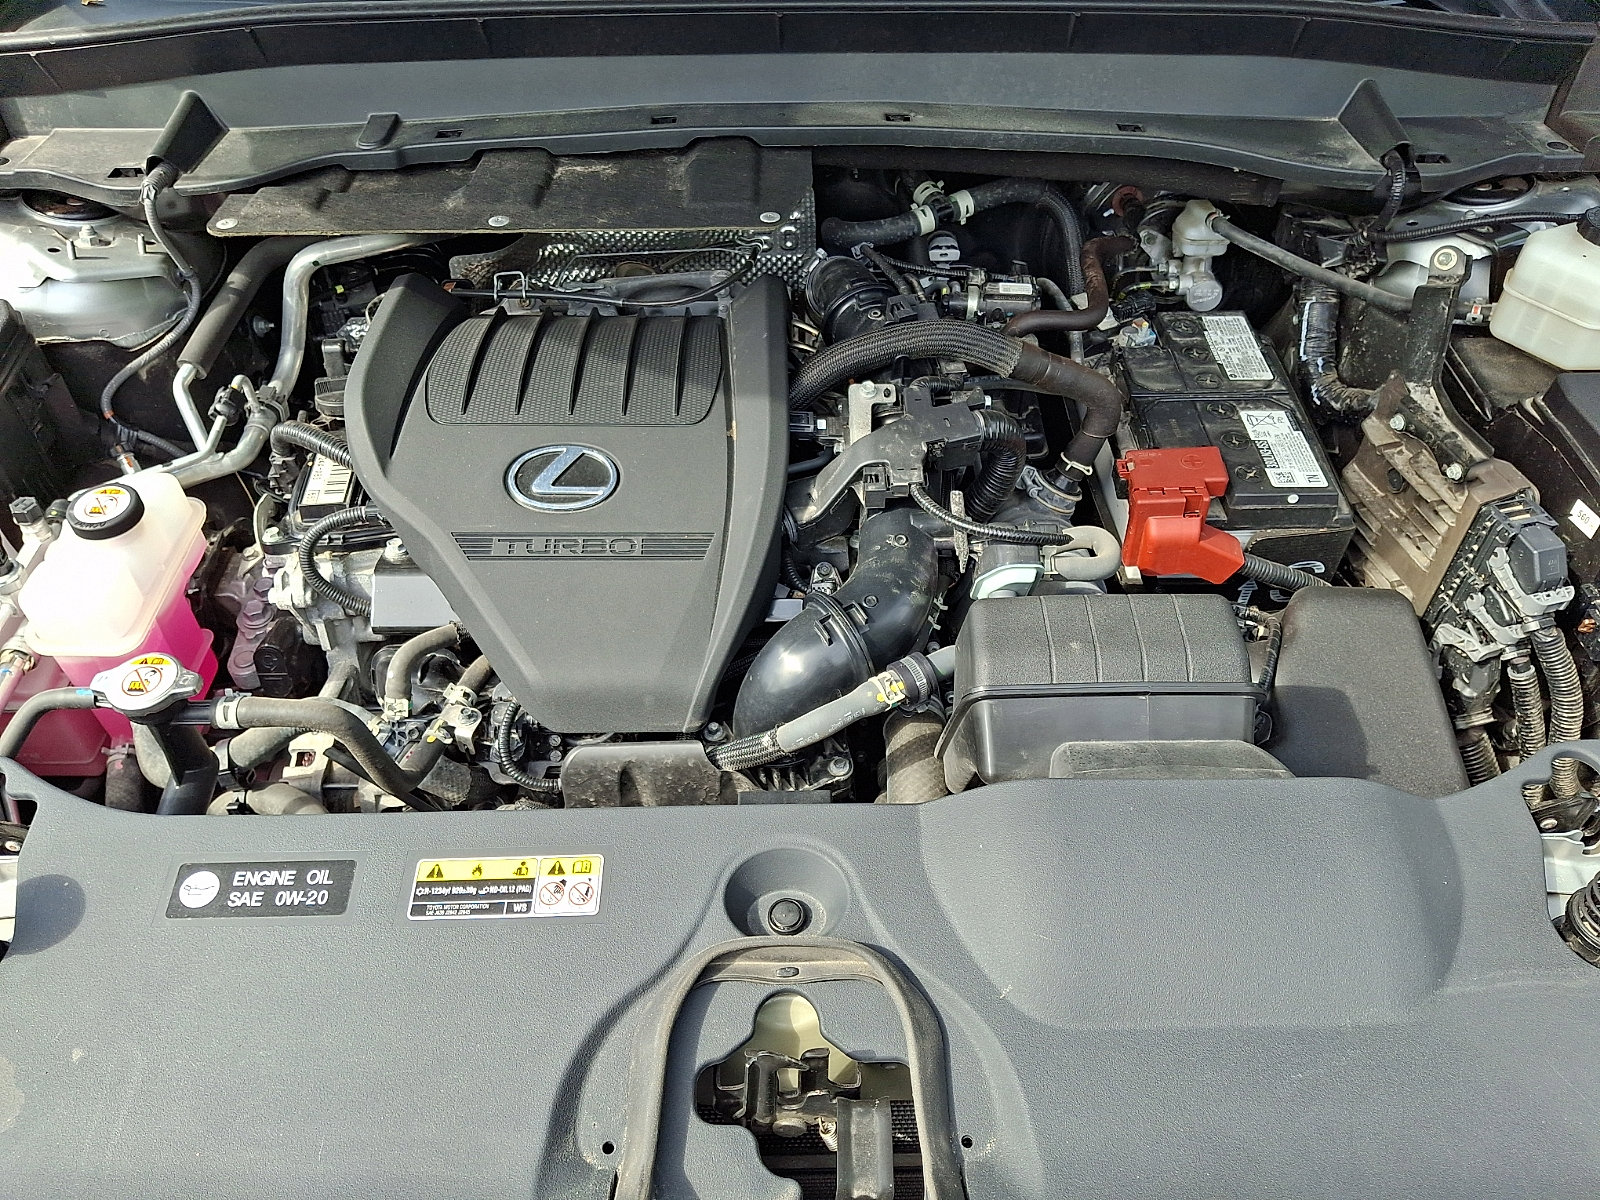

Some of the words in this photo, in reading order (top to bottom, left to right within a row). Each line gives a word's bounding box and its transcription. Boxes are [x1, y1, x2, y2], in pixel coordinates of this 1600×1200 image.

[496, 538, 639, 556] TURBO
[232, 870, 297, 887] ENGINE
[306, 869, 334, 885] OIL
[227, 891, 265, 908] SAE
[275, 890, 329, 907] 0W-20
